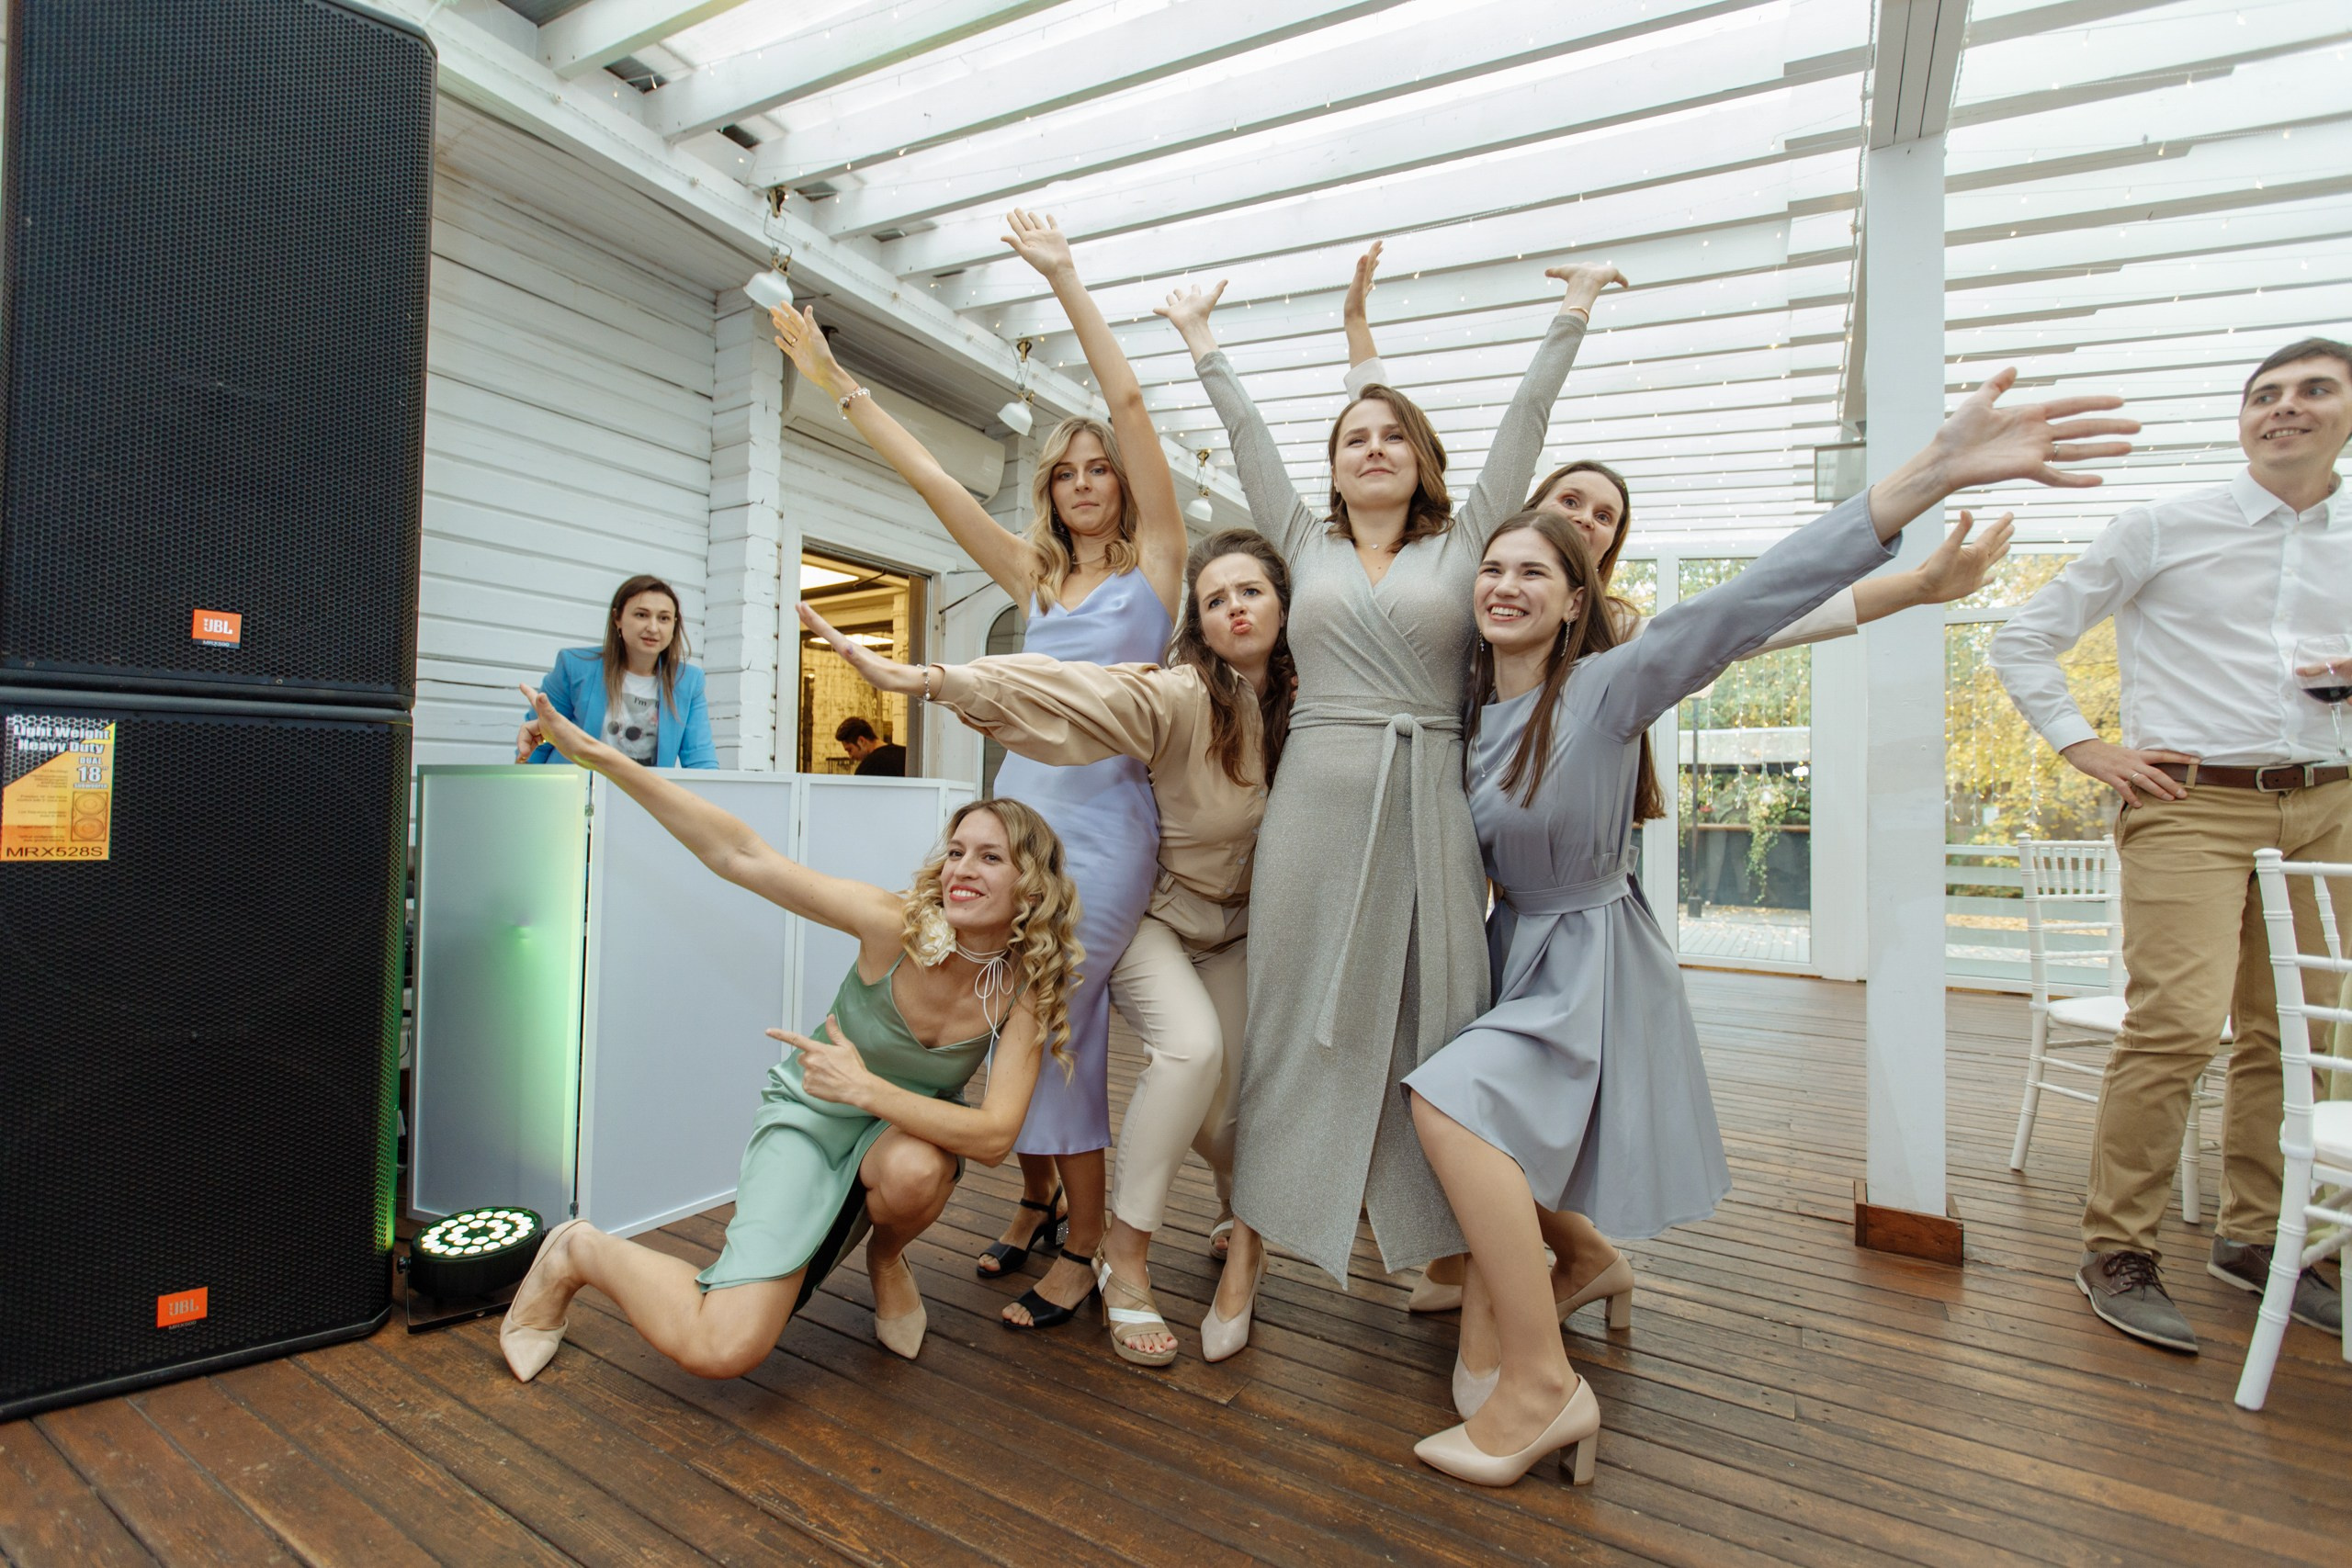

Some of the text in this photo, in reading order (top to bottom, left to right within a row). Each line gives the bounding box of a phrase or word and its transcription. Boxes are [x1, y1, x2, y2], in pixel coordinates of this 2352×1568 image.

[203, 618, 233, 635] JBL
[634, 697, 648, 706] I'm
[13, 724, 110, 740] Light Weight
[17, 739, 105, 754] Heavy Duty
[79, 757, 103, 765] DUAL
[6, 846, 103, 858] MRX528S
[168, 1298, 199, 1316] JBL
